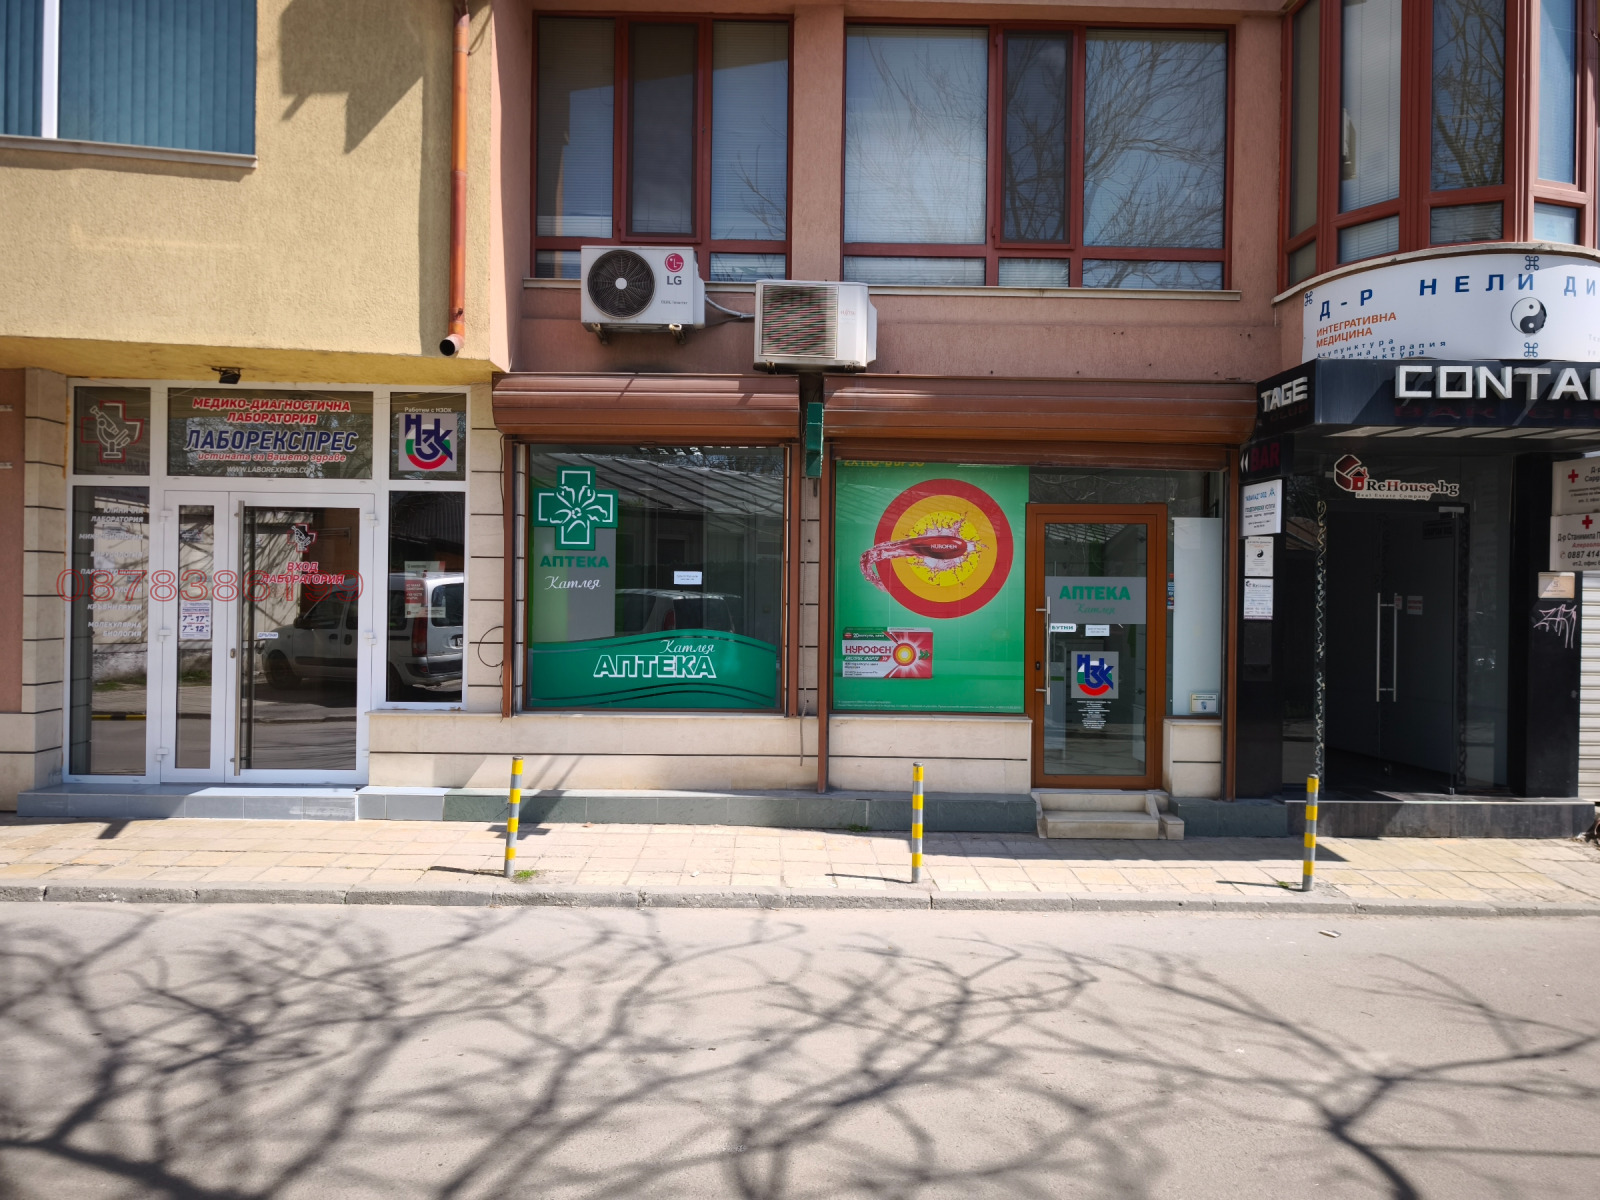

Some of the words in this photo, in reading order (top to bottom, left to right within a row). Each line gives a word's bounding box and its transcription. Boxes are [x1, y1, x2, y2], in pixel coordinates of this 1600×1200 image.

[667, 276, 682, 285] LG
[1319, 289, 1373, 321] Д-Р
[1419, 273, 1534, 298] НЕЛИ
[1316, 311, 1397, 337] ИНТЕГРАТИВНА
[1316, 327, 1373, 348] МЕДИЦИНА
[1382, 341, 1446, 353] терапия
[1261, 377, 1308, 413] TAGE
[192, 398, 351, 412] МЕДИКО-ДИАГНОСТИЧНА
[226, 412, 318, 424] ЛАБОРАТОРИЯ
[184, 430, 359, 451] ЛАБОРЕКСПРЕС
[198, 453, 251, 461] истината
[266, 453, 309, 461] Вашето
[310, 454, 346, 463] здраве
[1251, 442, 1280, 473] BAR
[1366, 480, 1460, 496] ReHouse.bg
[91, 515, 144, 523] ЛАБОРАТОРИЯ
[540, 555, 609, 568] АПТЕКА
[1567, 551, 1584, 559] 0887
[287, 562, 319, 573] ВХОД
[260, 574, 345, 584] ЛАБОРАТОРИЯ
[544, 576, 601, 590] Катлея
[1059, 586, 1131, 600] АПТЕКА
[1074, 603, 1115, 615] Катлея
[660, 640, 715, 653] Катлея
[845, 645, 892, 654] НУРОФЕН
[593, 655, 717, 678] АПТЕКА
